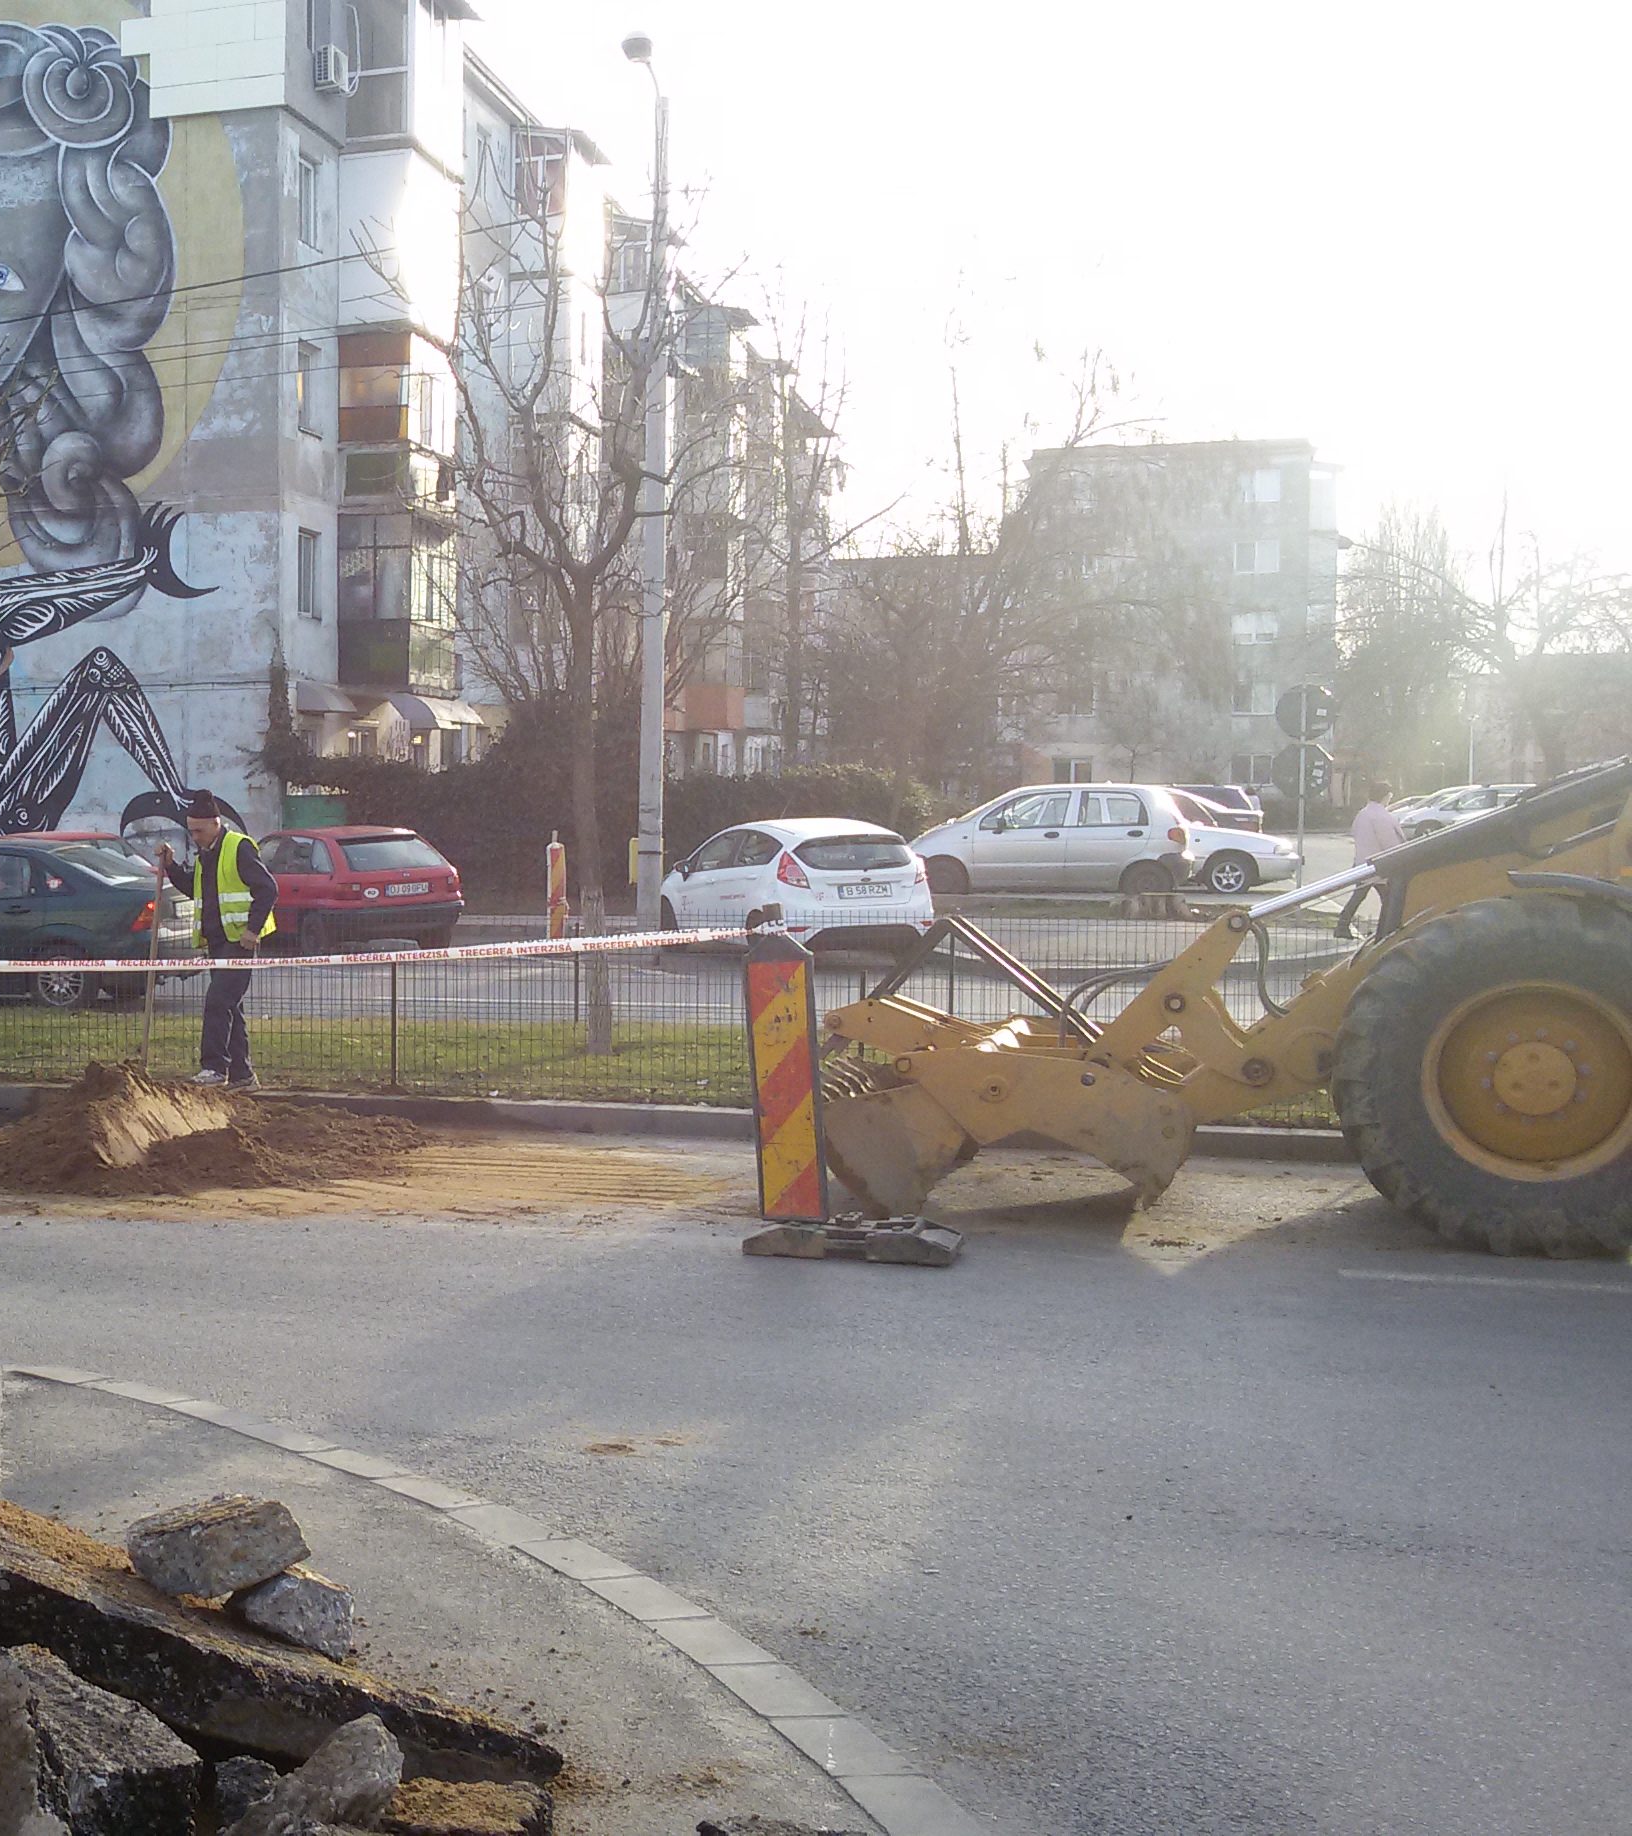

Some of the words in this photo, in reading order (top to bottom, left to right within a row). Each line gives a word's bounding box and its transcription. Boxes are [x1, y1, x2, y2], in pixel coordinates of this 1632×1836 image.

[582, 940, 638, 951] TRECEREA
[341, 952, 393, 963] TRECEREA
[459, 947, 513, 958] TRECEREA
